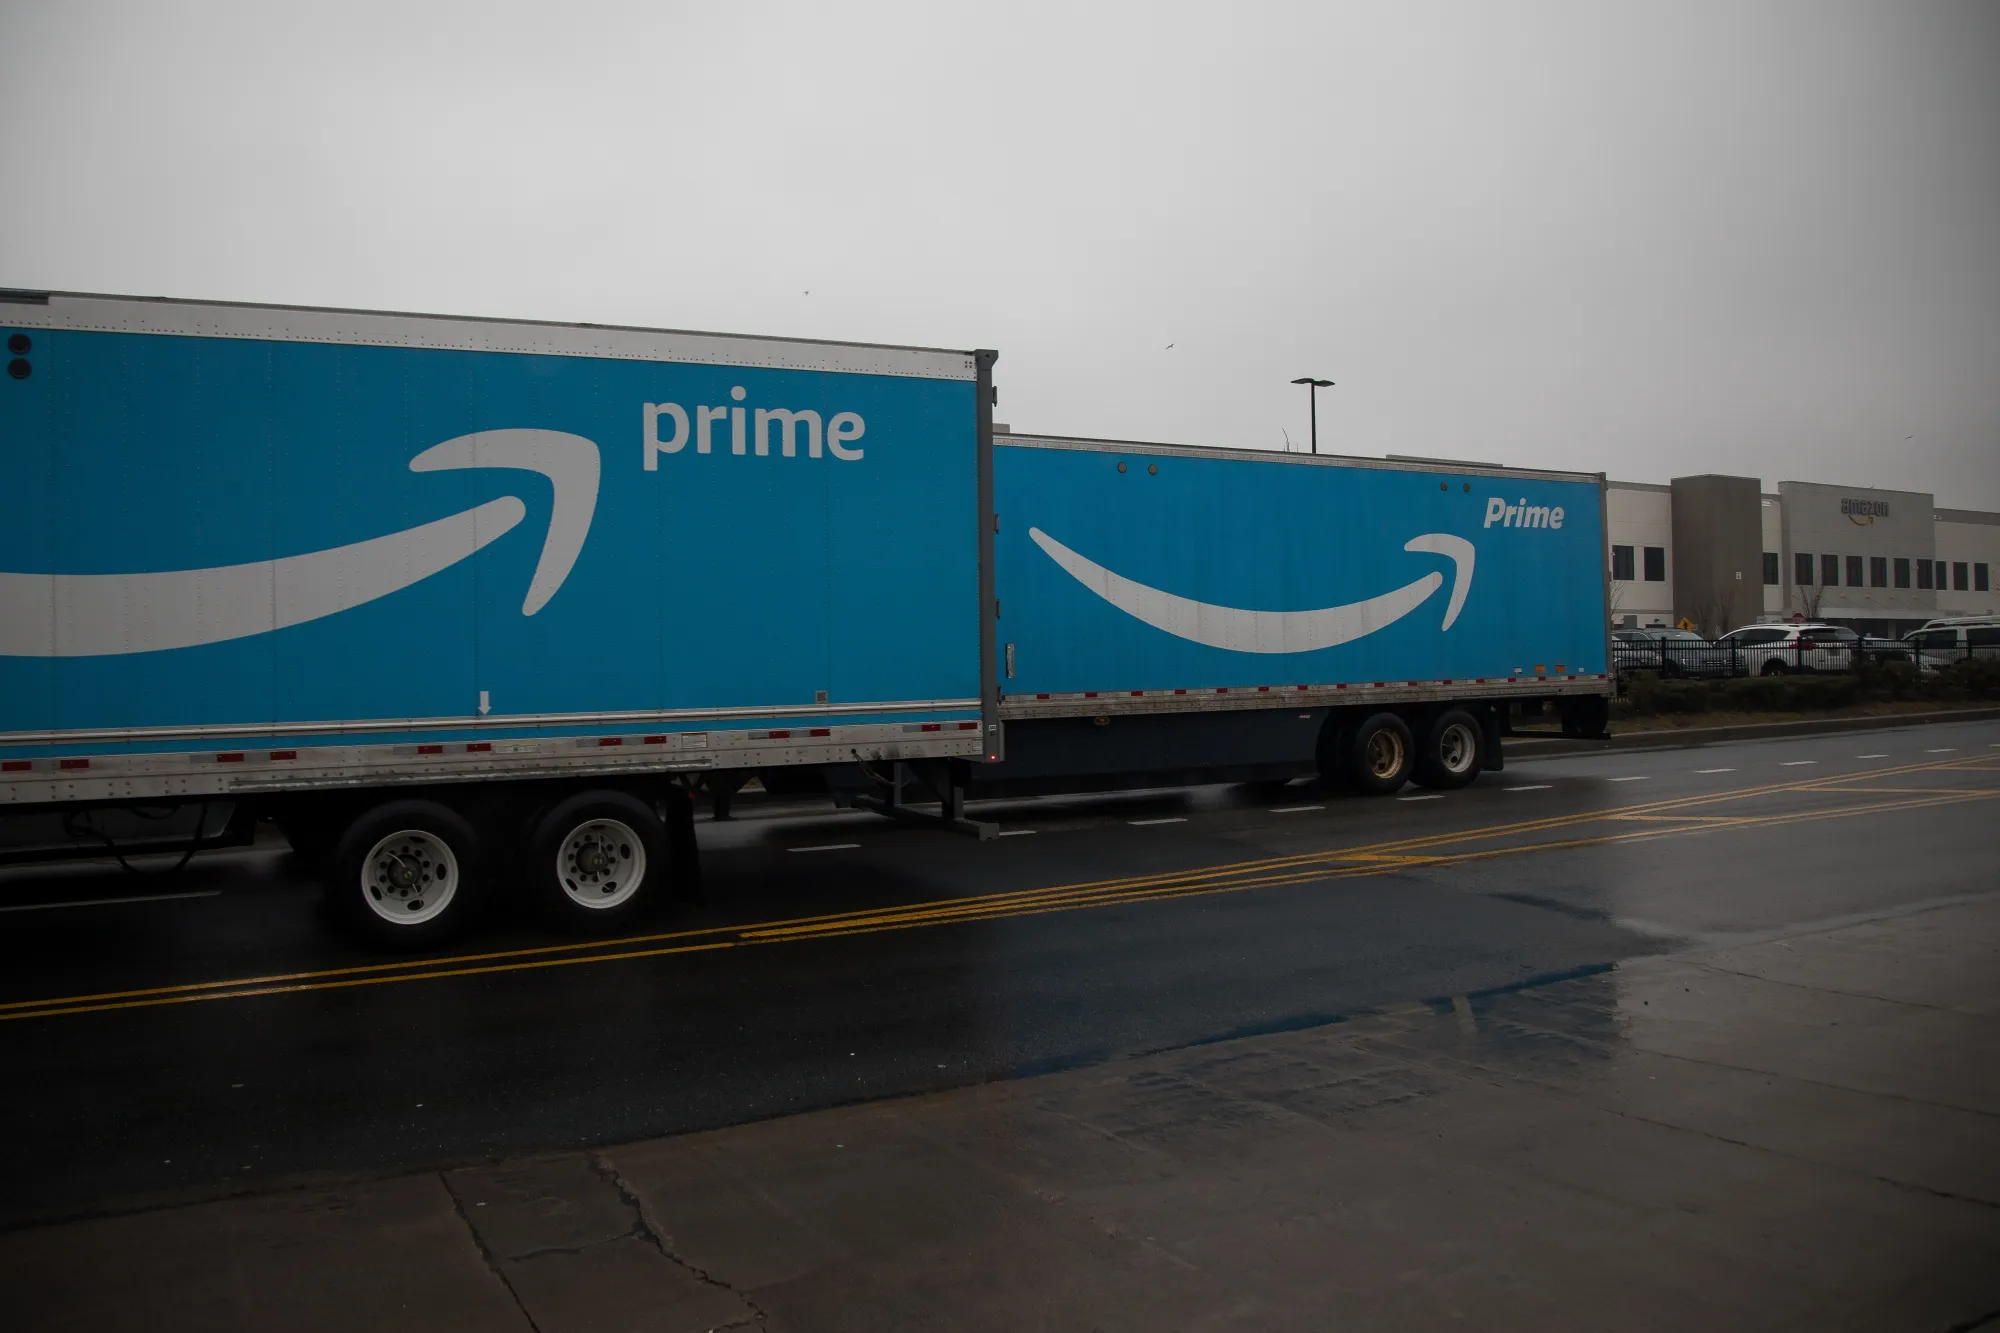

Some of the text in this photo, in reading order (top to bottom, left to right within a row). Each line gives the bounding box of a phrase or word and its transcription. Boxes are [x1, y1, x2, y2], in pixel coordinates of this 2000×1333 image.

[643, 386, 865, 472] prime
[1483, 497, 1565, 529] Prime
[1840, 498, 1889, 517] amazon
